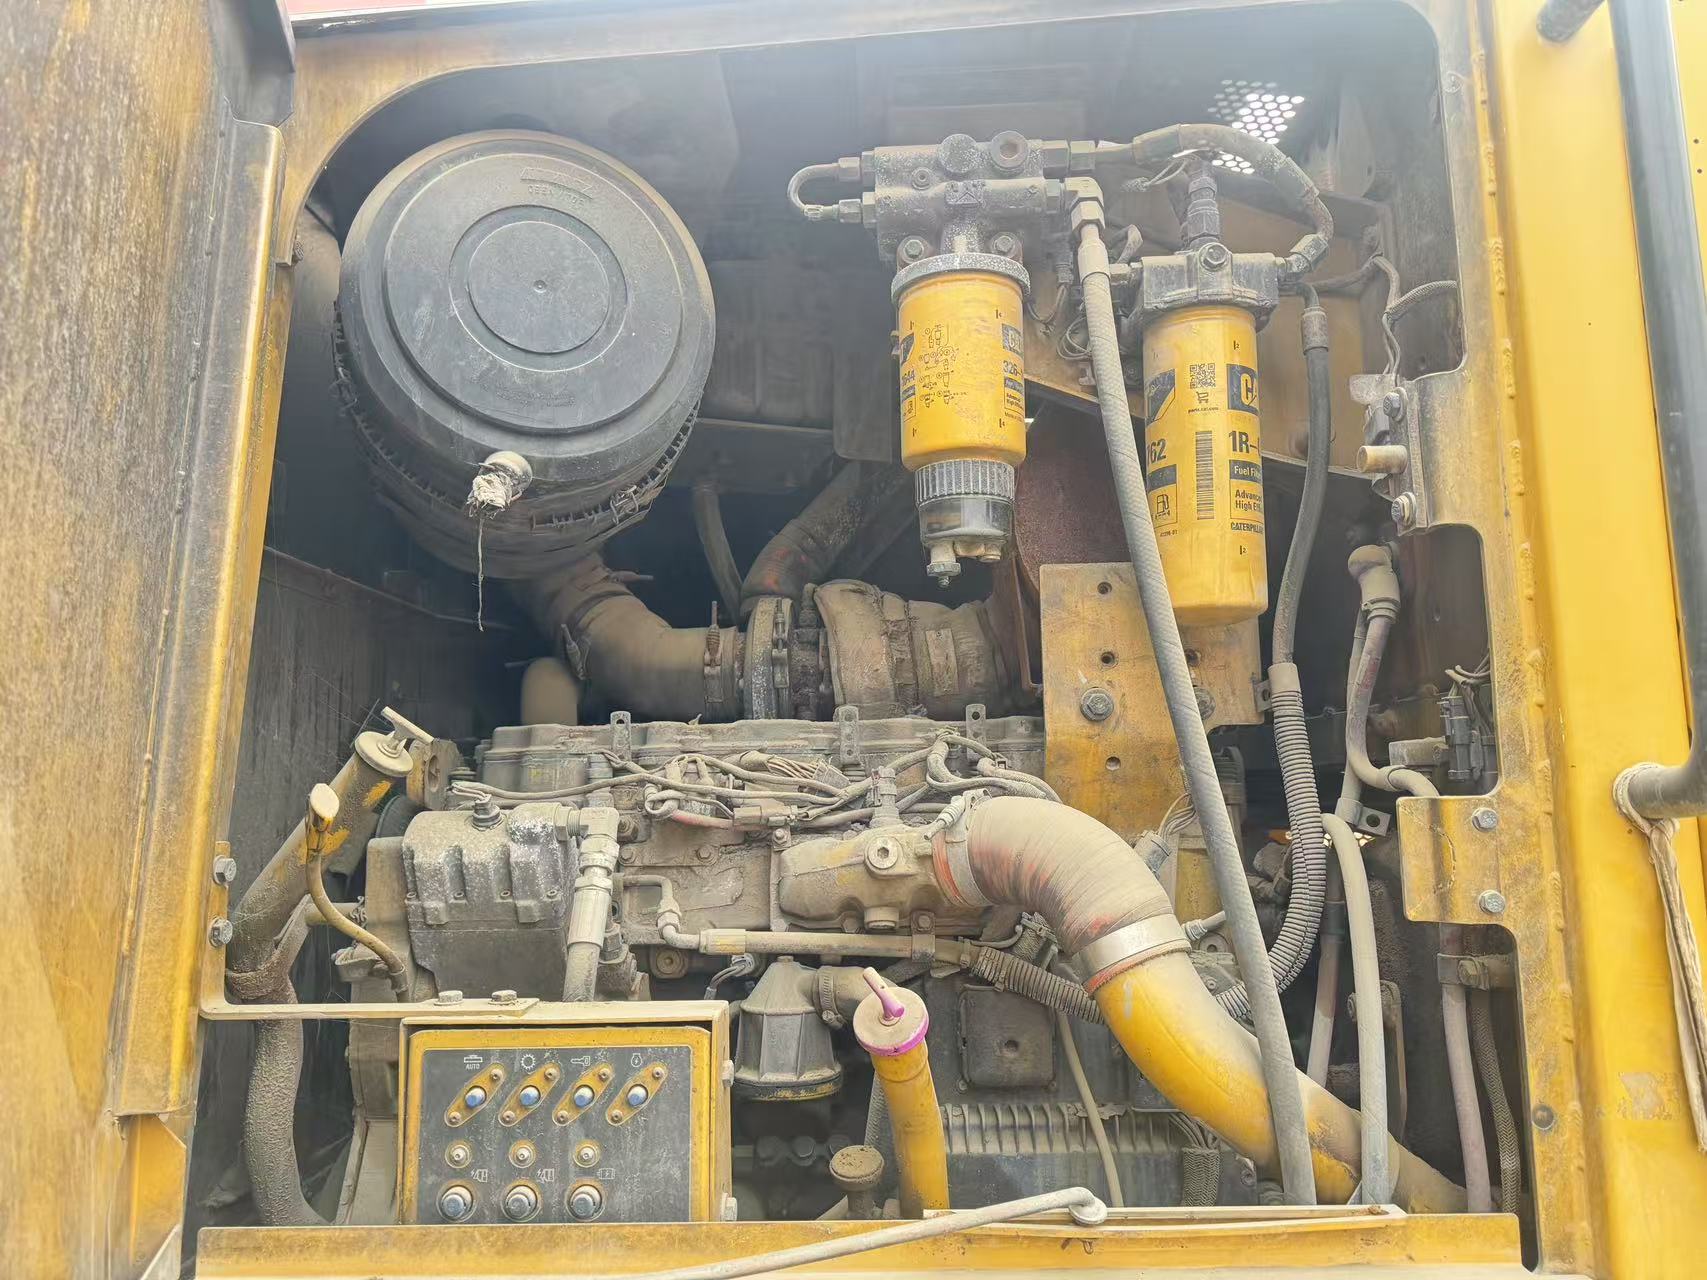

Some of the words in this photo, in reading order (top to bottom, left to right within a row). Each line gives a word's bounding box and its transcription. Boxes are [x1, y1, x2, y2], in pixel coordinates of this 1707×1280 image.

[1228, 430, 1260, 456] 1R-
[1234, 465, 1250, 476] Fuel
[1235, 501, 1253, 512] High
